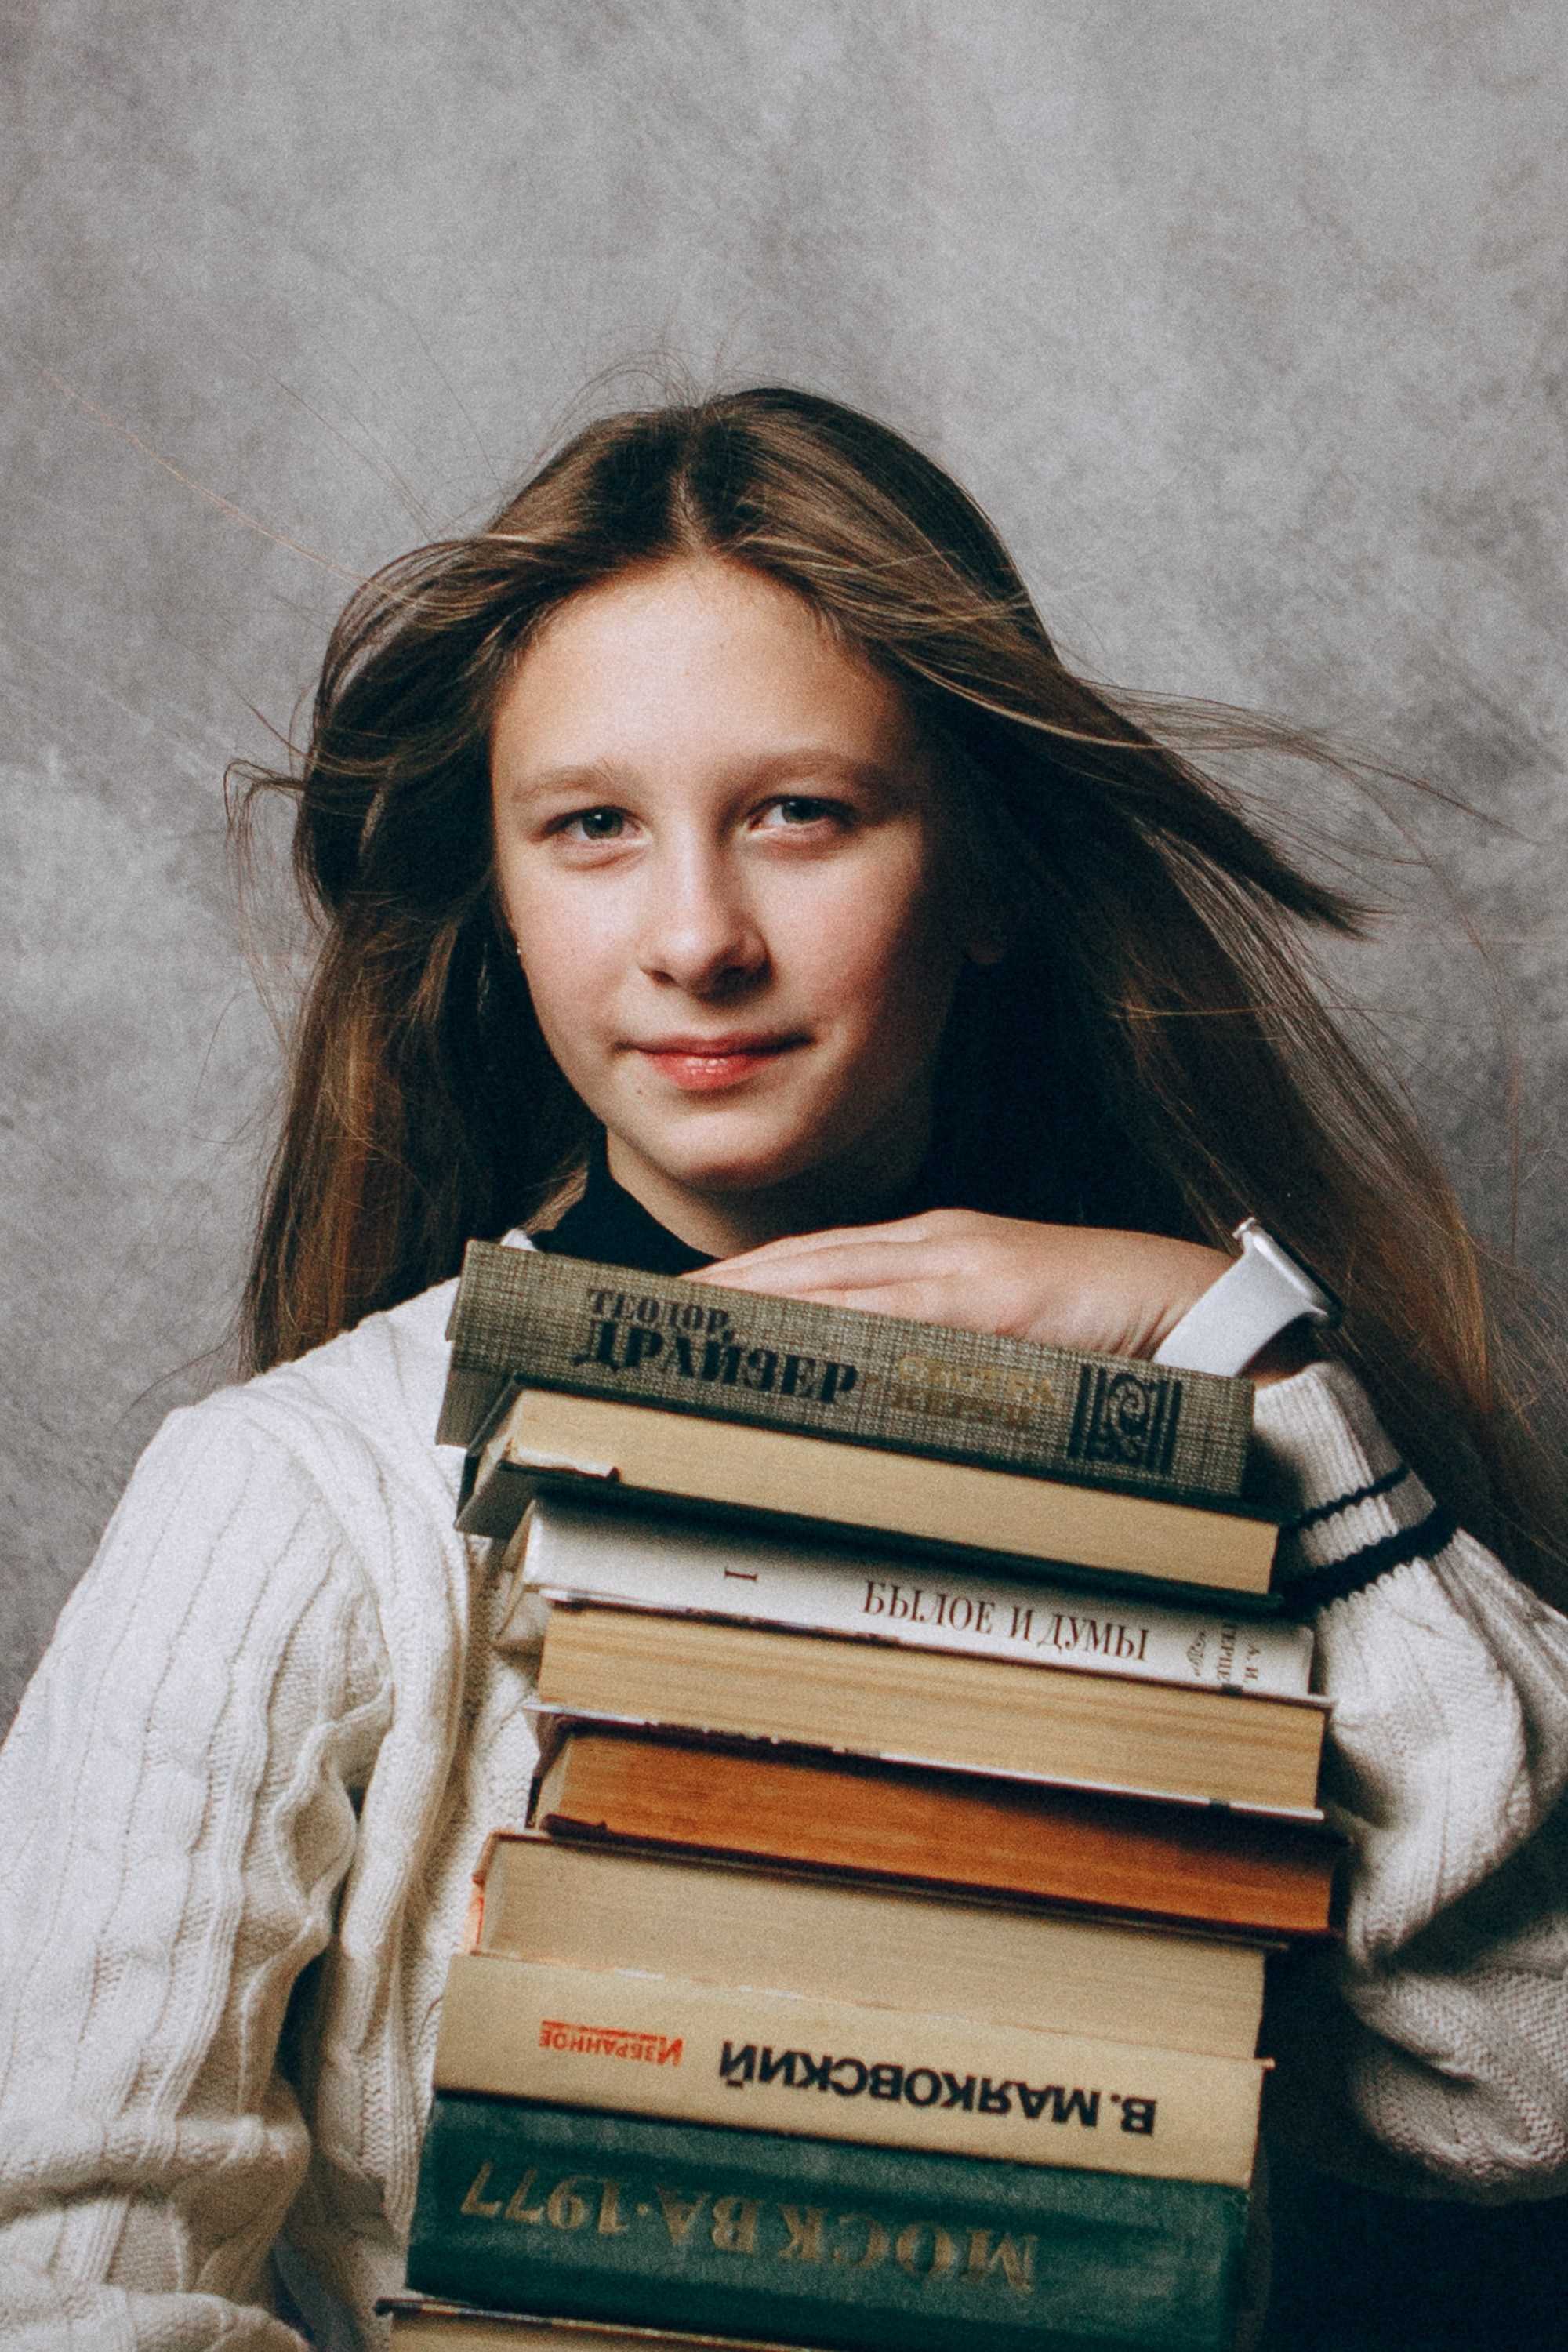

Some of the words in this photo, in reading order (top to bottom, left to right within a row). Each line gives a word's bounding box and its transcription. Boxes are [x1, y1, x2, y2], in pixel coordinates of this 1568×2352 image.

[588, 1288, 730, 1333] ТЕОДОР
[572, 1319, 859, 1403] ДРАЙЗЕР
[862, 1581, 995, 1635] БЫЛОЕ
[1008, 1606, 1035, 1643] И
[1038, 1612, 1151, 1662] ДУМЫ
[1215, 1623, 1238, 1683] ГЕРЦЕ
[539, 2028, 684, 2067] ИЗБРАННОЕ
[719, 2040, 1102, 2129] МАЯКОВСКИЙ
[1110, 2090, 1158, 2136] В.
